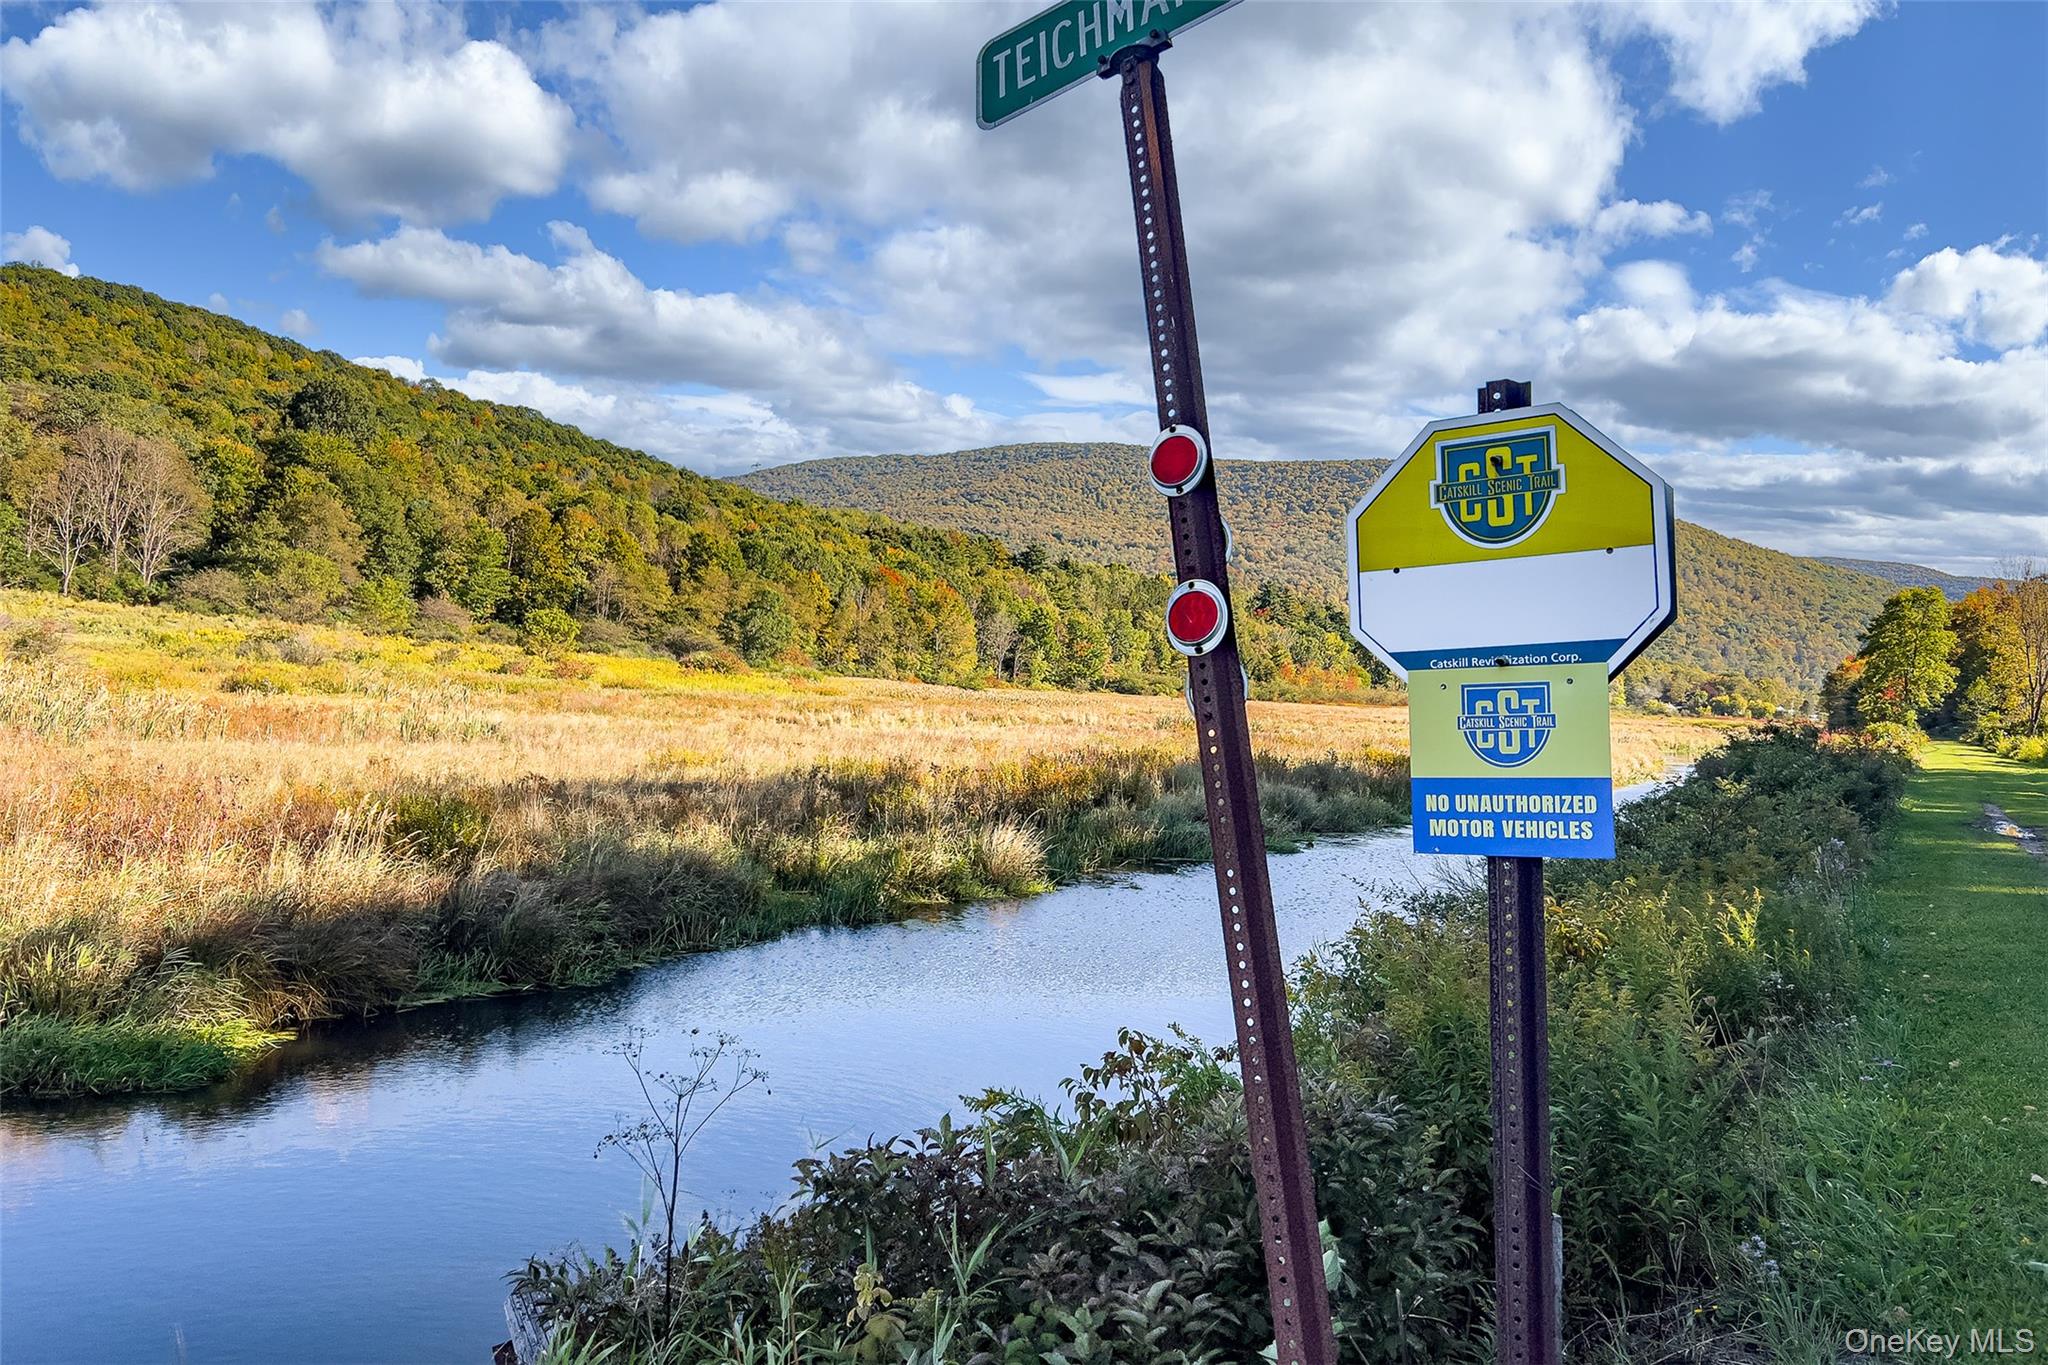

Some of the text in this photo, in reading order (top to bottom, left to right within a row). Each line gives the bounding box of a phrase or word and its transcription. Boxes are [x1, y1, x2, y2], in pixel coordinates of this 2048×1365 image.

[993, 0, 1184, 98] TEICHMA
[1439, 475, 1557, 502] CATSKILL SCENIC TRAIL
[1458, 446, 1538, 528] CST
[1430, 652, 1582, 669] Catskill Reviization Corp.
[1459, 714, 1554, 730] CATSKILL SCENIC TRAIL
[1475, 690, 1540, 754] CST
[1426, 794, 1598, 814] NO UNAUTHORIZED
[1429, 819, 1594, 840] MOTOR VEHICLES
